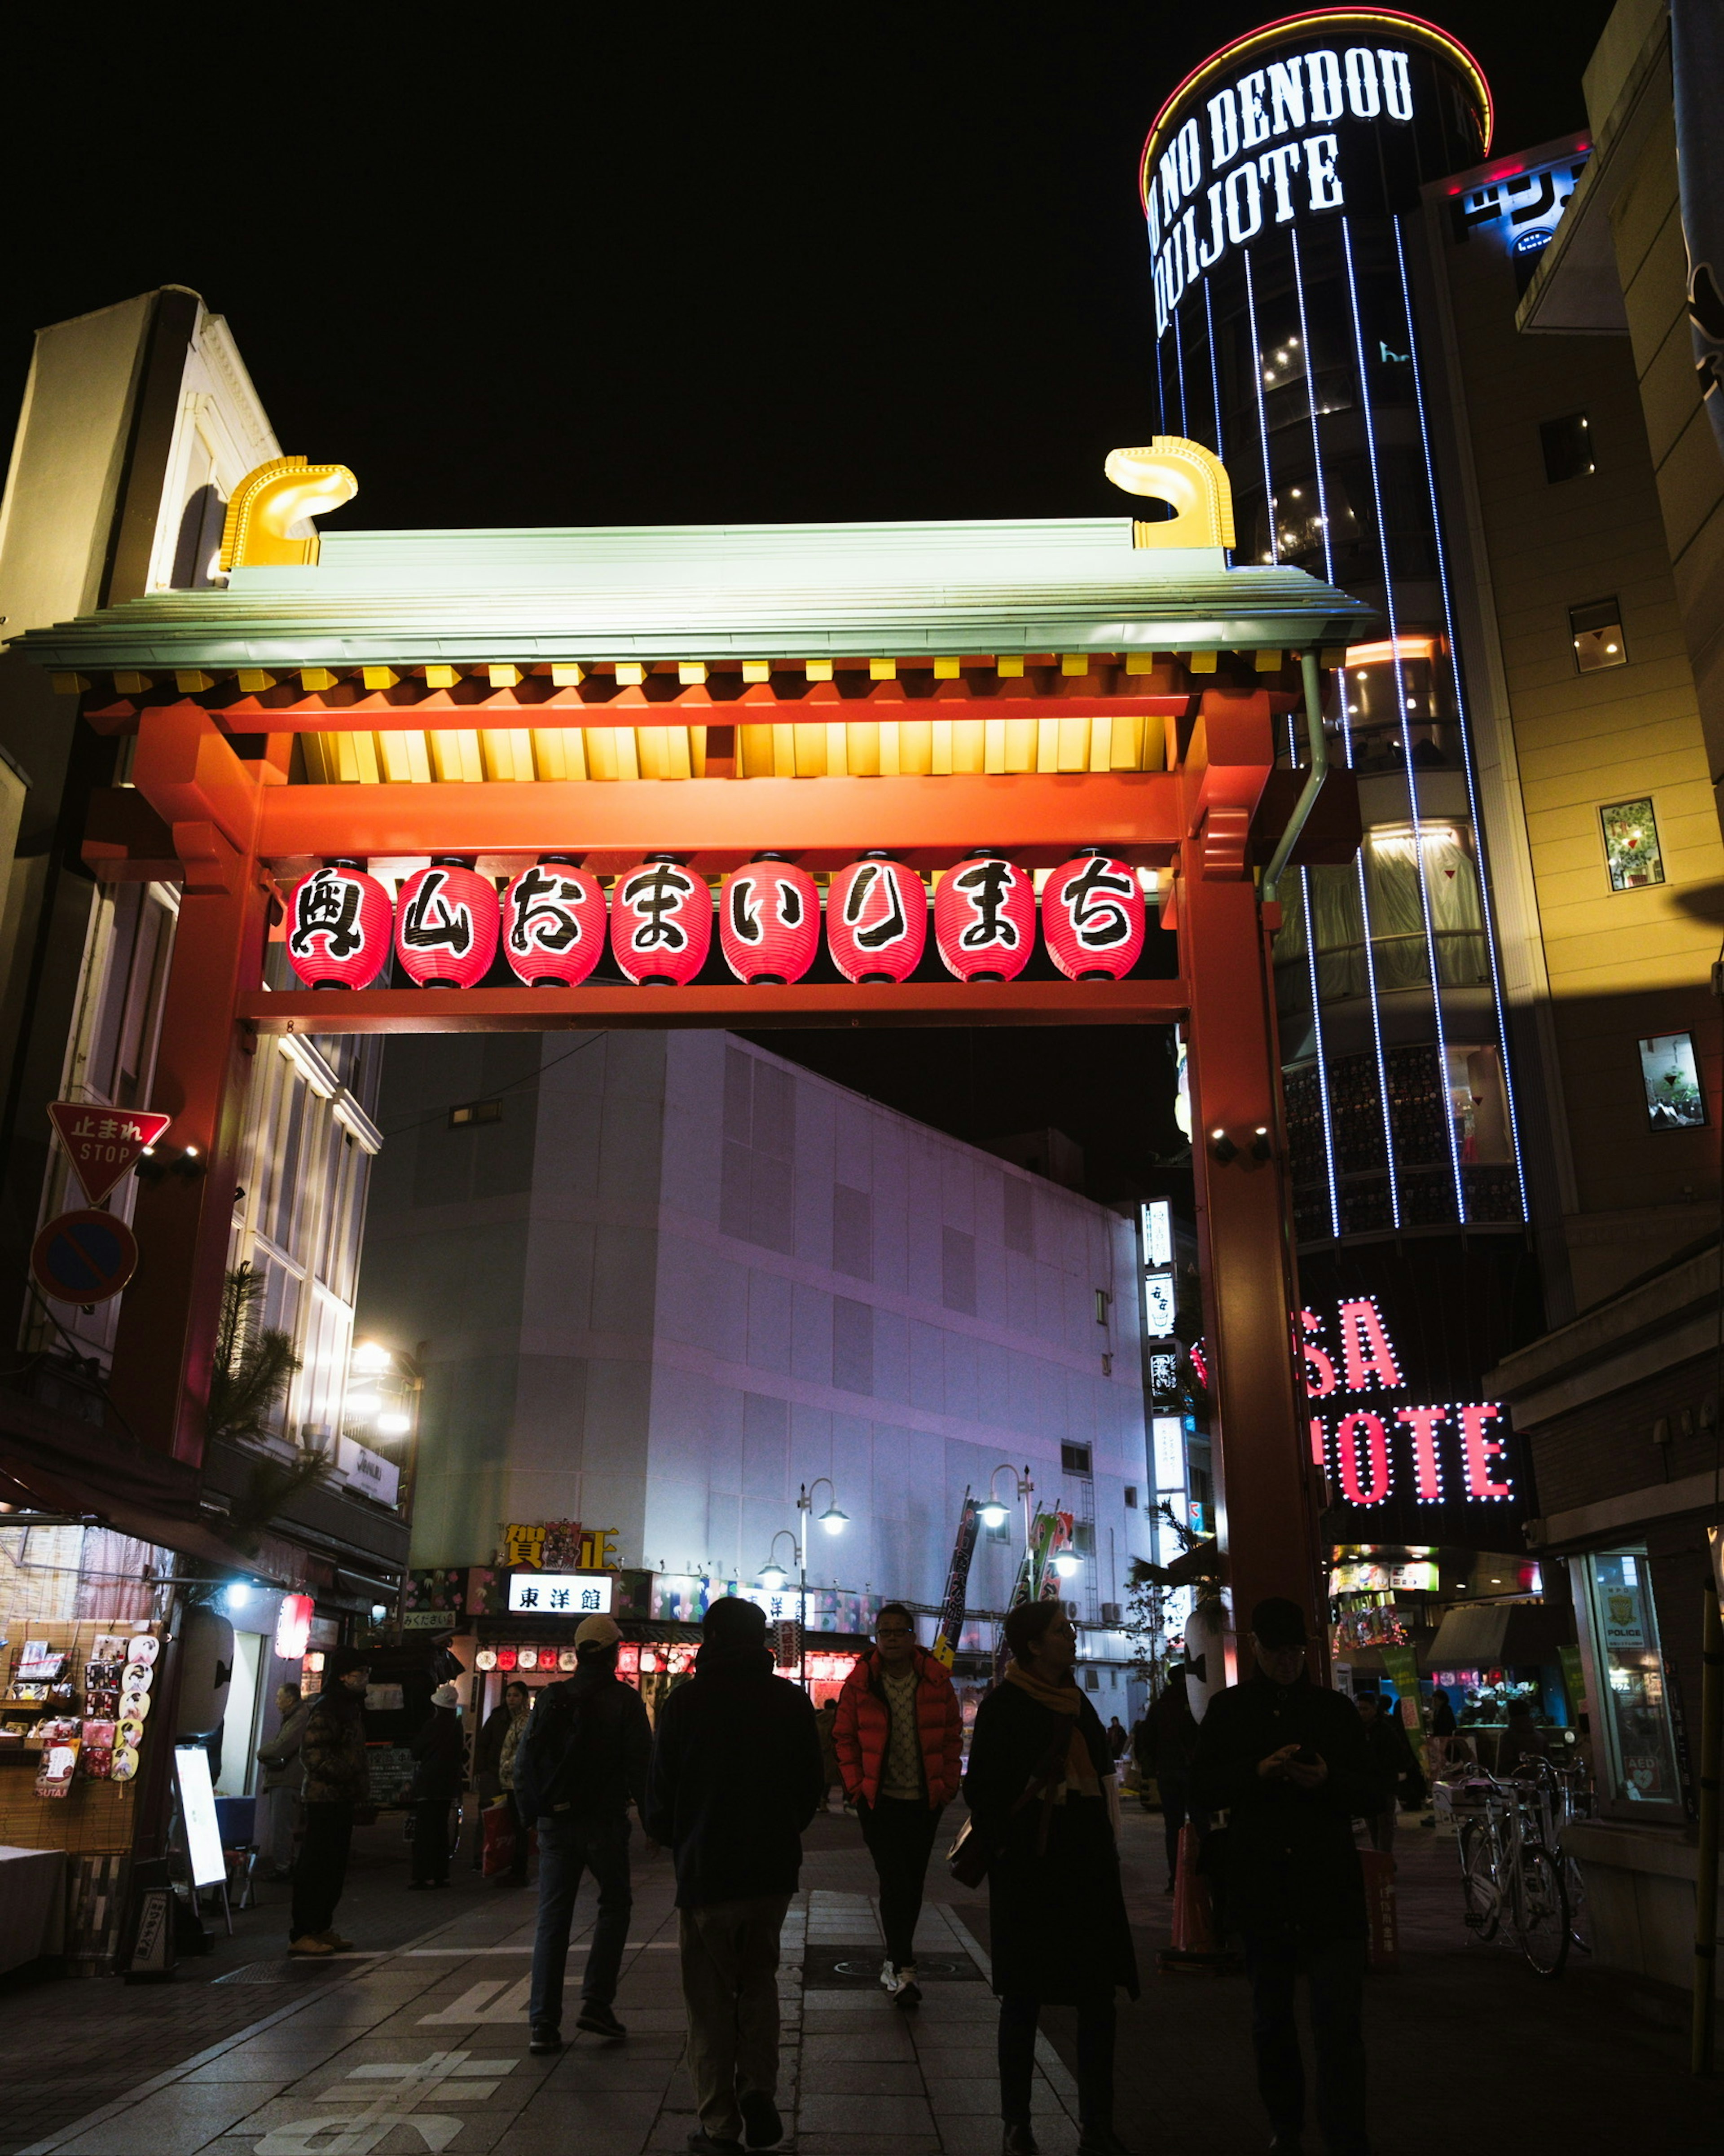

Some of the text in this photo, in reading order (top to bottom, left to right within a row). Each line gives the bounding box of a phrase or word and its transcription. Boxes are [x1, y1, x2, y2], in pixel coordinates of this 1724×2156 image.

[1159, 117, 1202, 228] NO
[1206, 47, 1414, 170] DENDOU
[1152, 133, 1345, 338] QUIJOTE
[288, 857, 1136, 961] 奥山おまいりまち
[70, 1115, 144, 1142] 止まれ
[80, 1142, 130, 1164] STOP
[520, 1587, 601, 1610] 東洋館
[1628, 1759, 1655, 1768] AED
